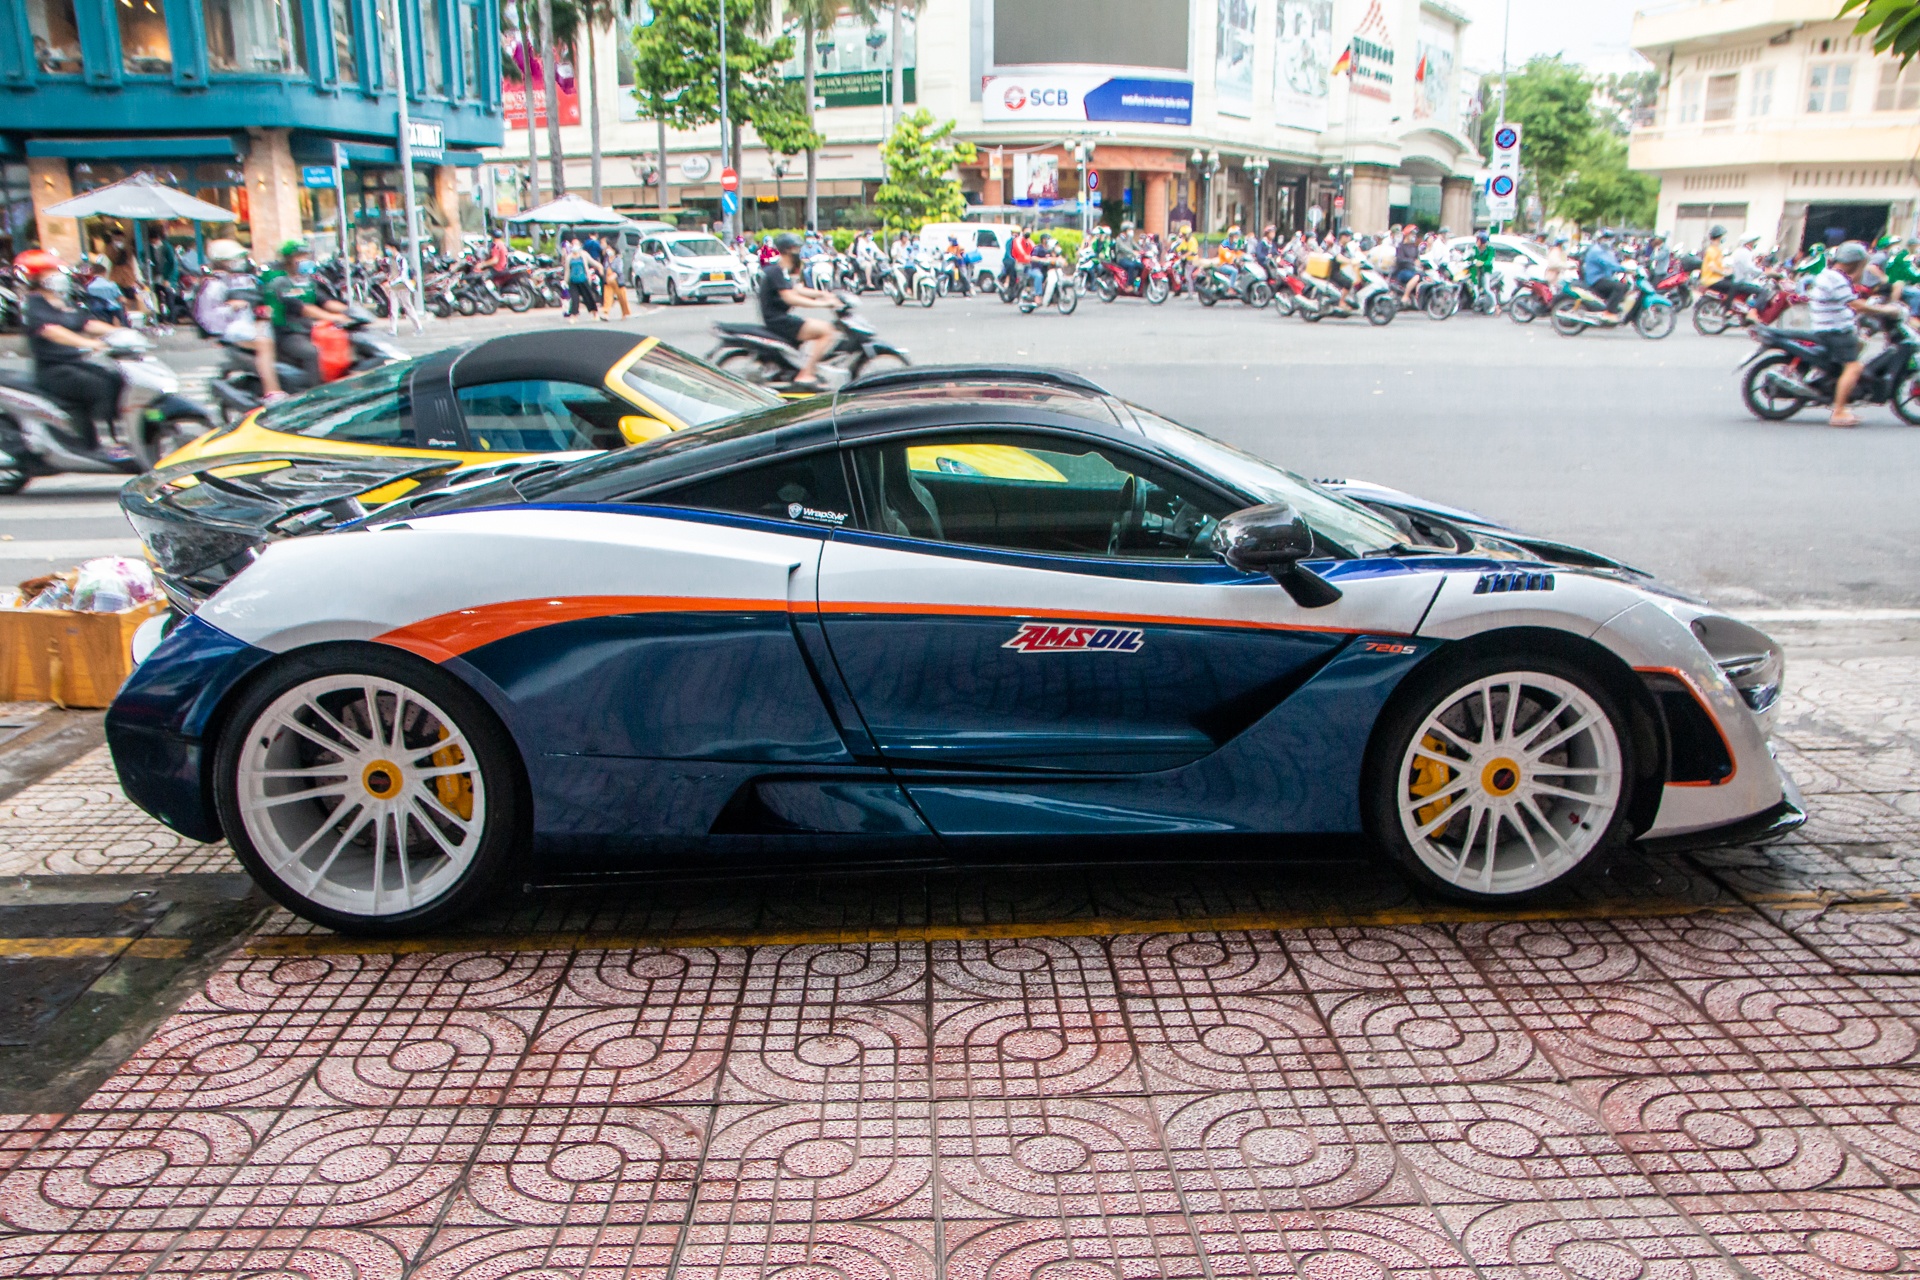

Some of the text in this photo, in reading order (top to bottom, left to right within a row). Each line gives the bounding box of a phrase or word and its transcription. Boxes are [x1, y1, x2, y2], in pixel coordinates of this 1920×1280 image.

[1030, 88, 1068, 106] SCB
[1009, 625, 1143, 651] AMSOIL
[1365, 642, 1417, 655] 720S
